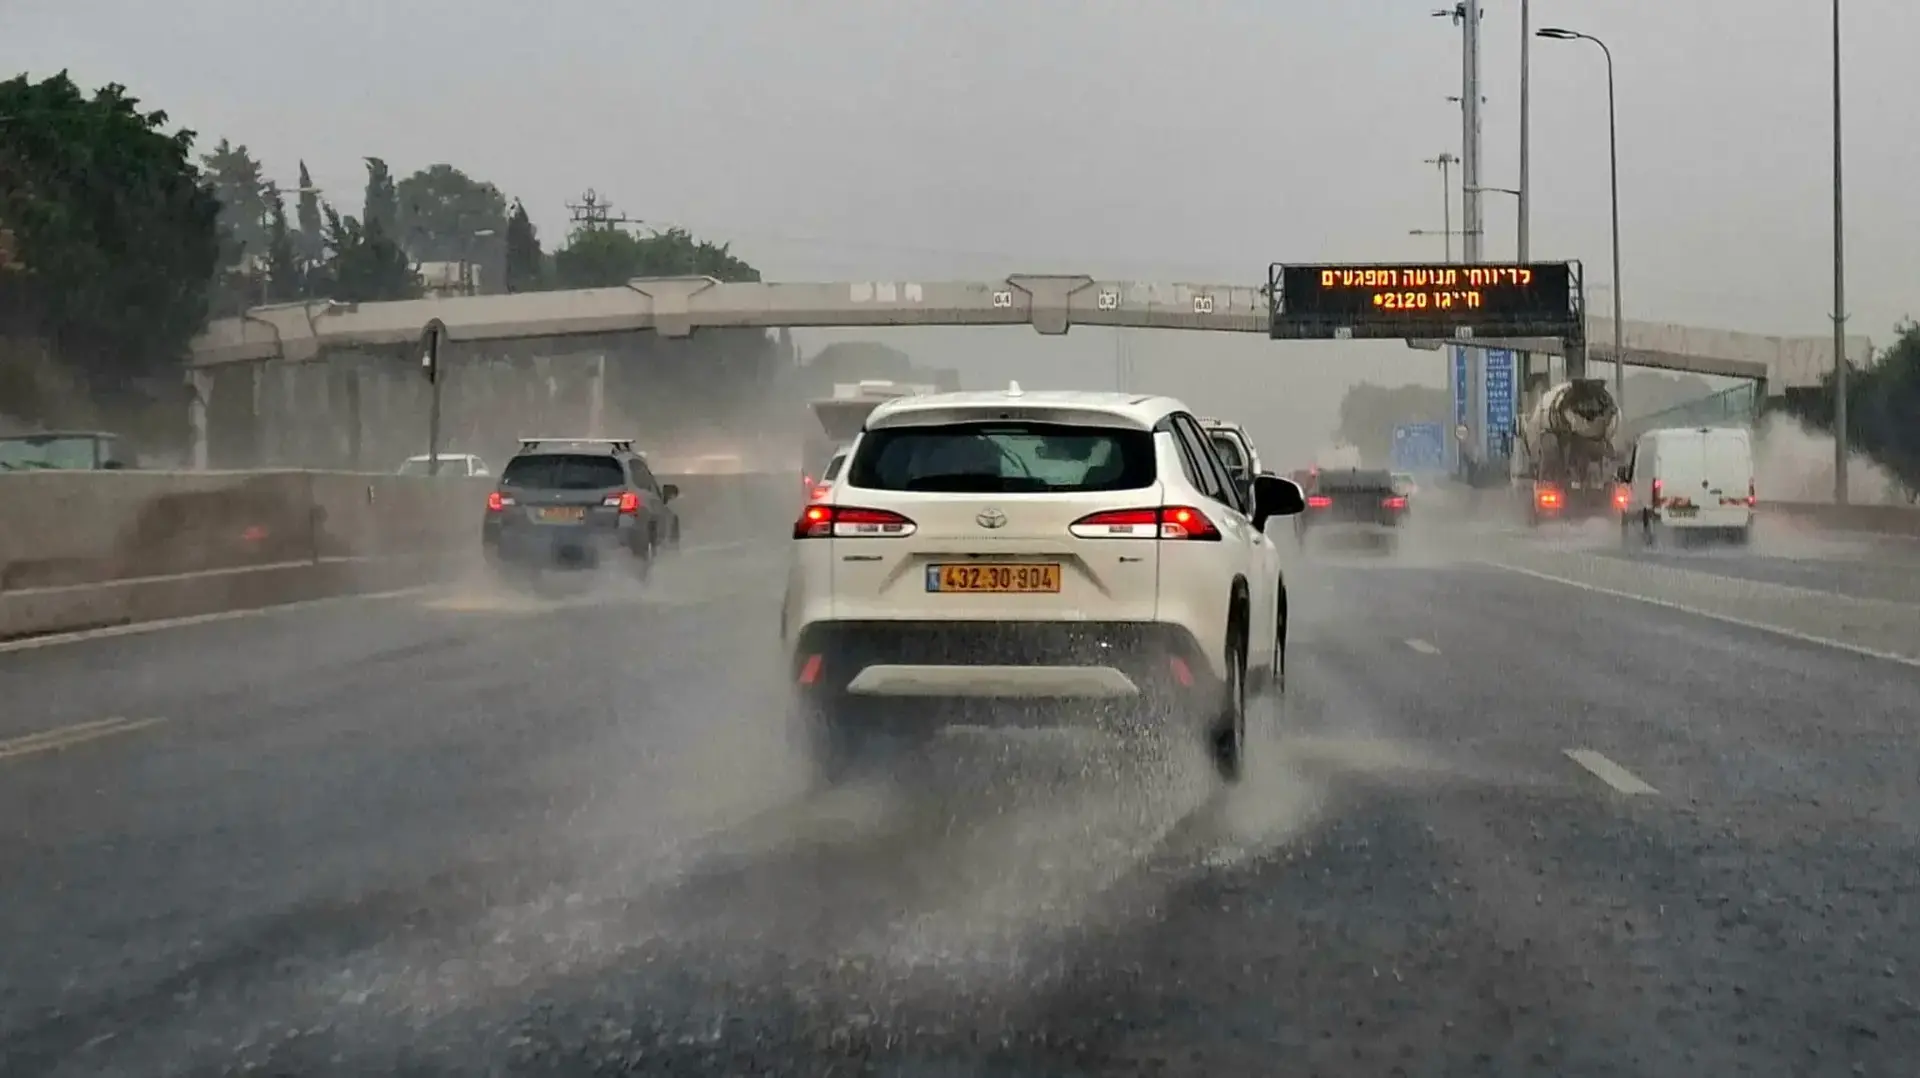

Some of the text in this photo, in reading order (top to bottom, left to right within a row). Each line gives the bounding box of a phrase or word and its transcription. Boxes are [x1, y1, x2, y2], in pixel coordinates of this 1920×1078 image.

[1321, 269, 1397, 286] ומפגעים
[1403, 268, 1456, 286] תנועה
[1433, 291, 1480, 308] חייגו
